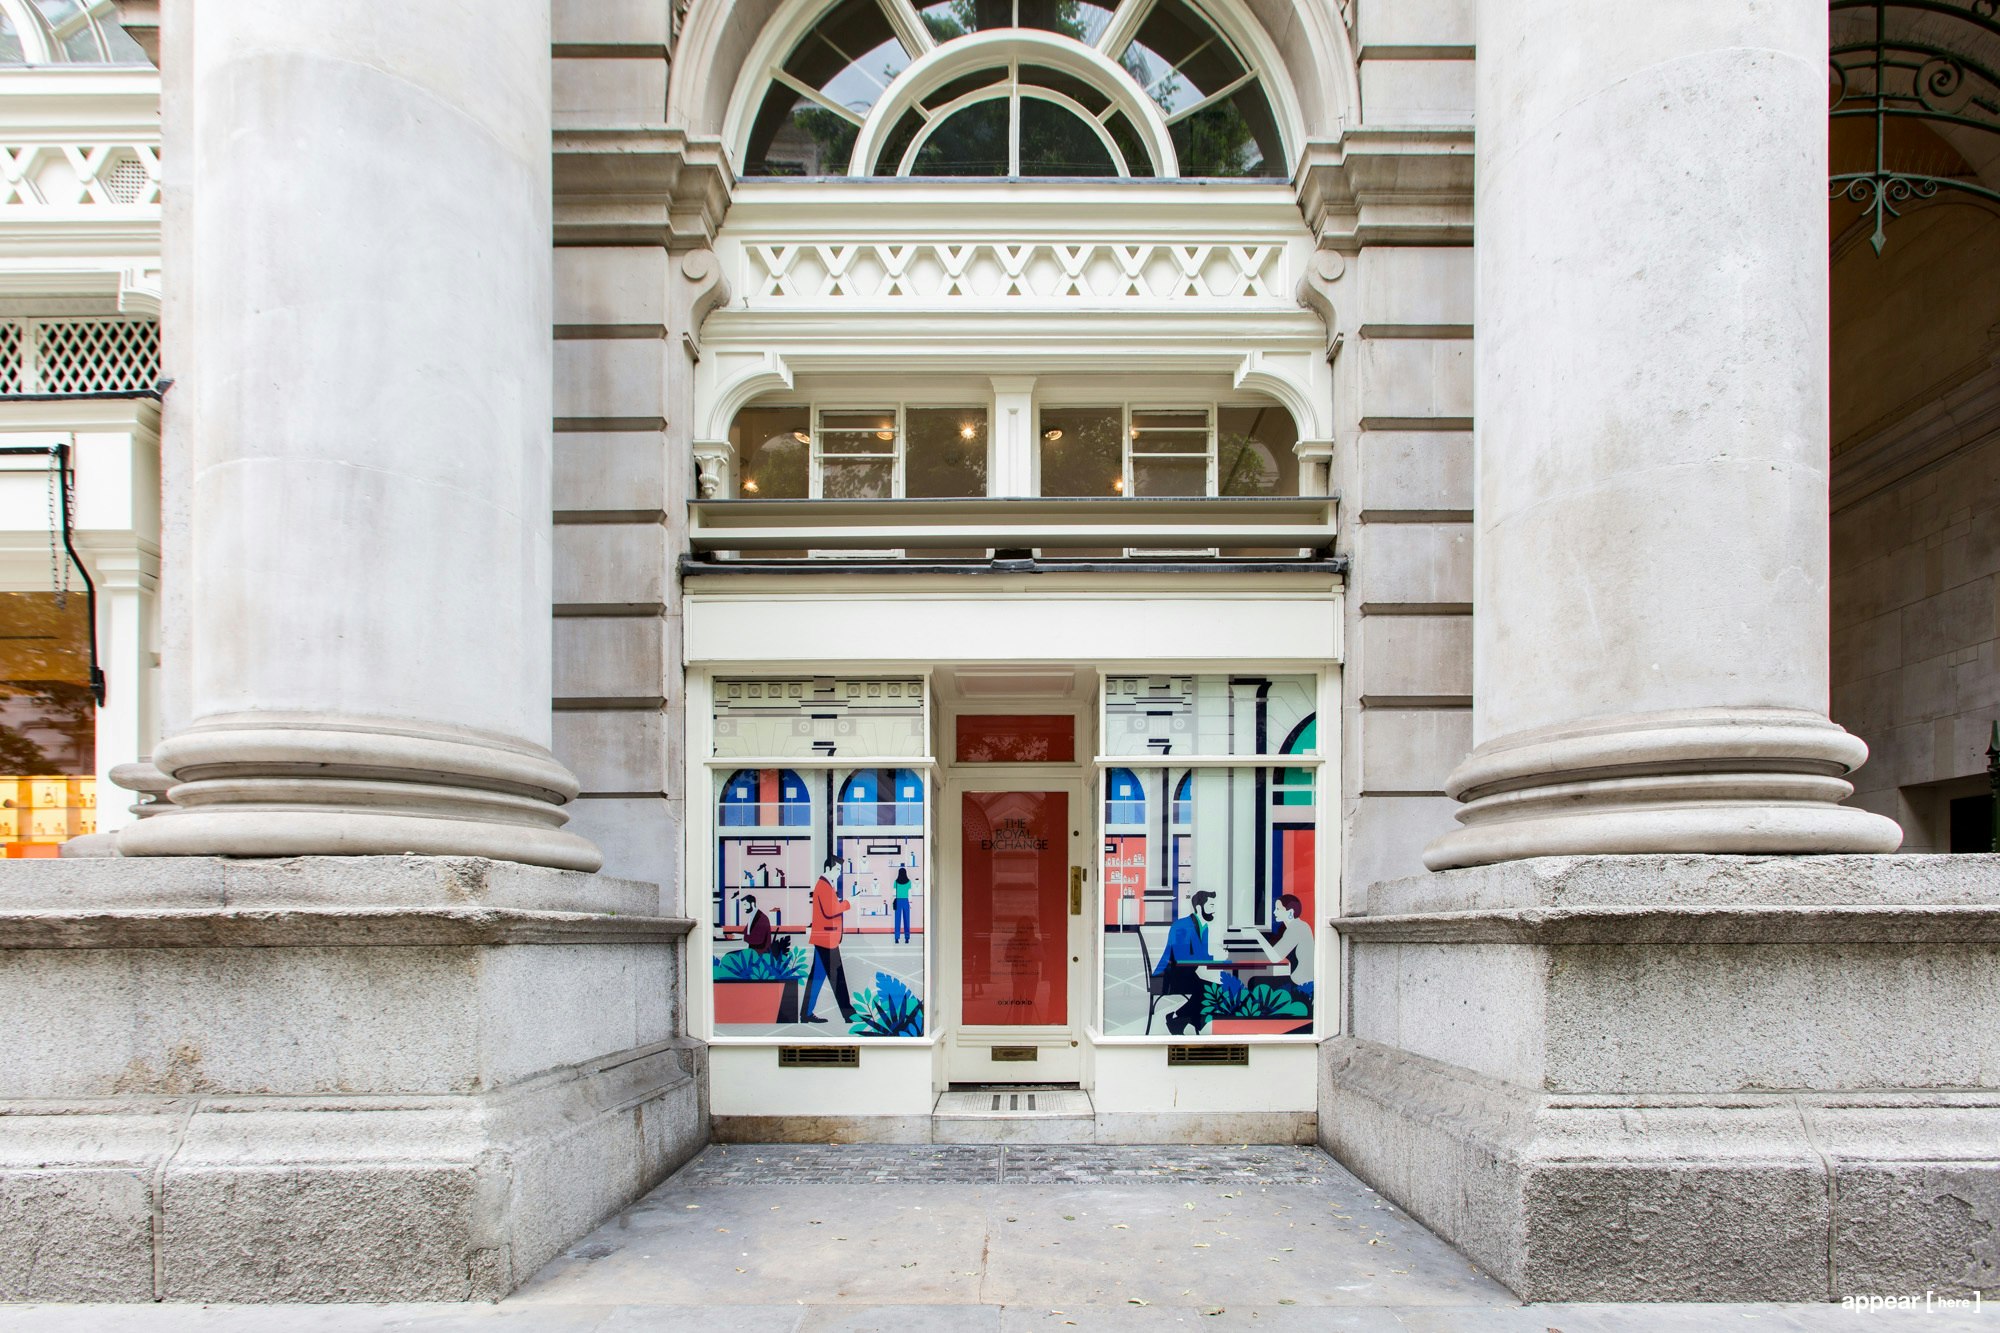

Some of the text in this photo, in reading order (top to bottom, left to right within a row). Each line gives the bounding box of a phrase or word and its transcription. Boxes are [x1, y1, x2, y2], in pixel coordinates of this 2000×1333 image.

[1004, 818, 1026, 829] THE
[995, 829, 1032, 840] ROYAL
[981, 839, 1049, 850] EXCHANGE
